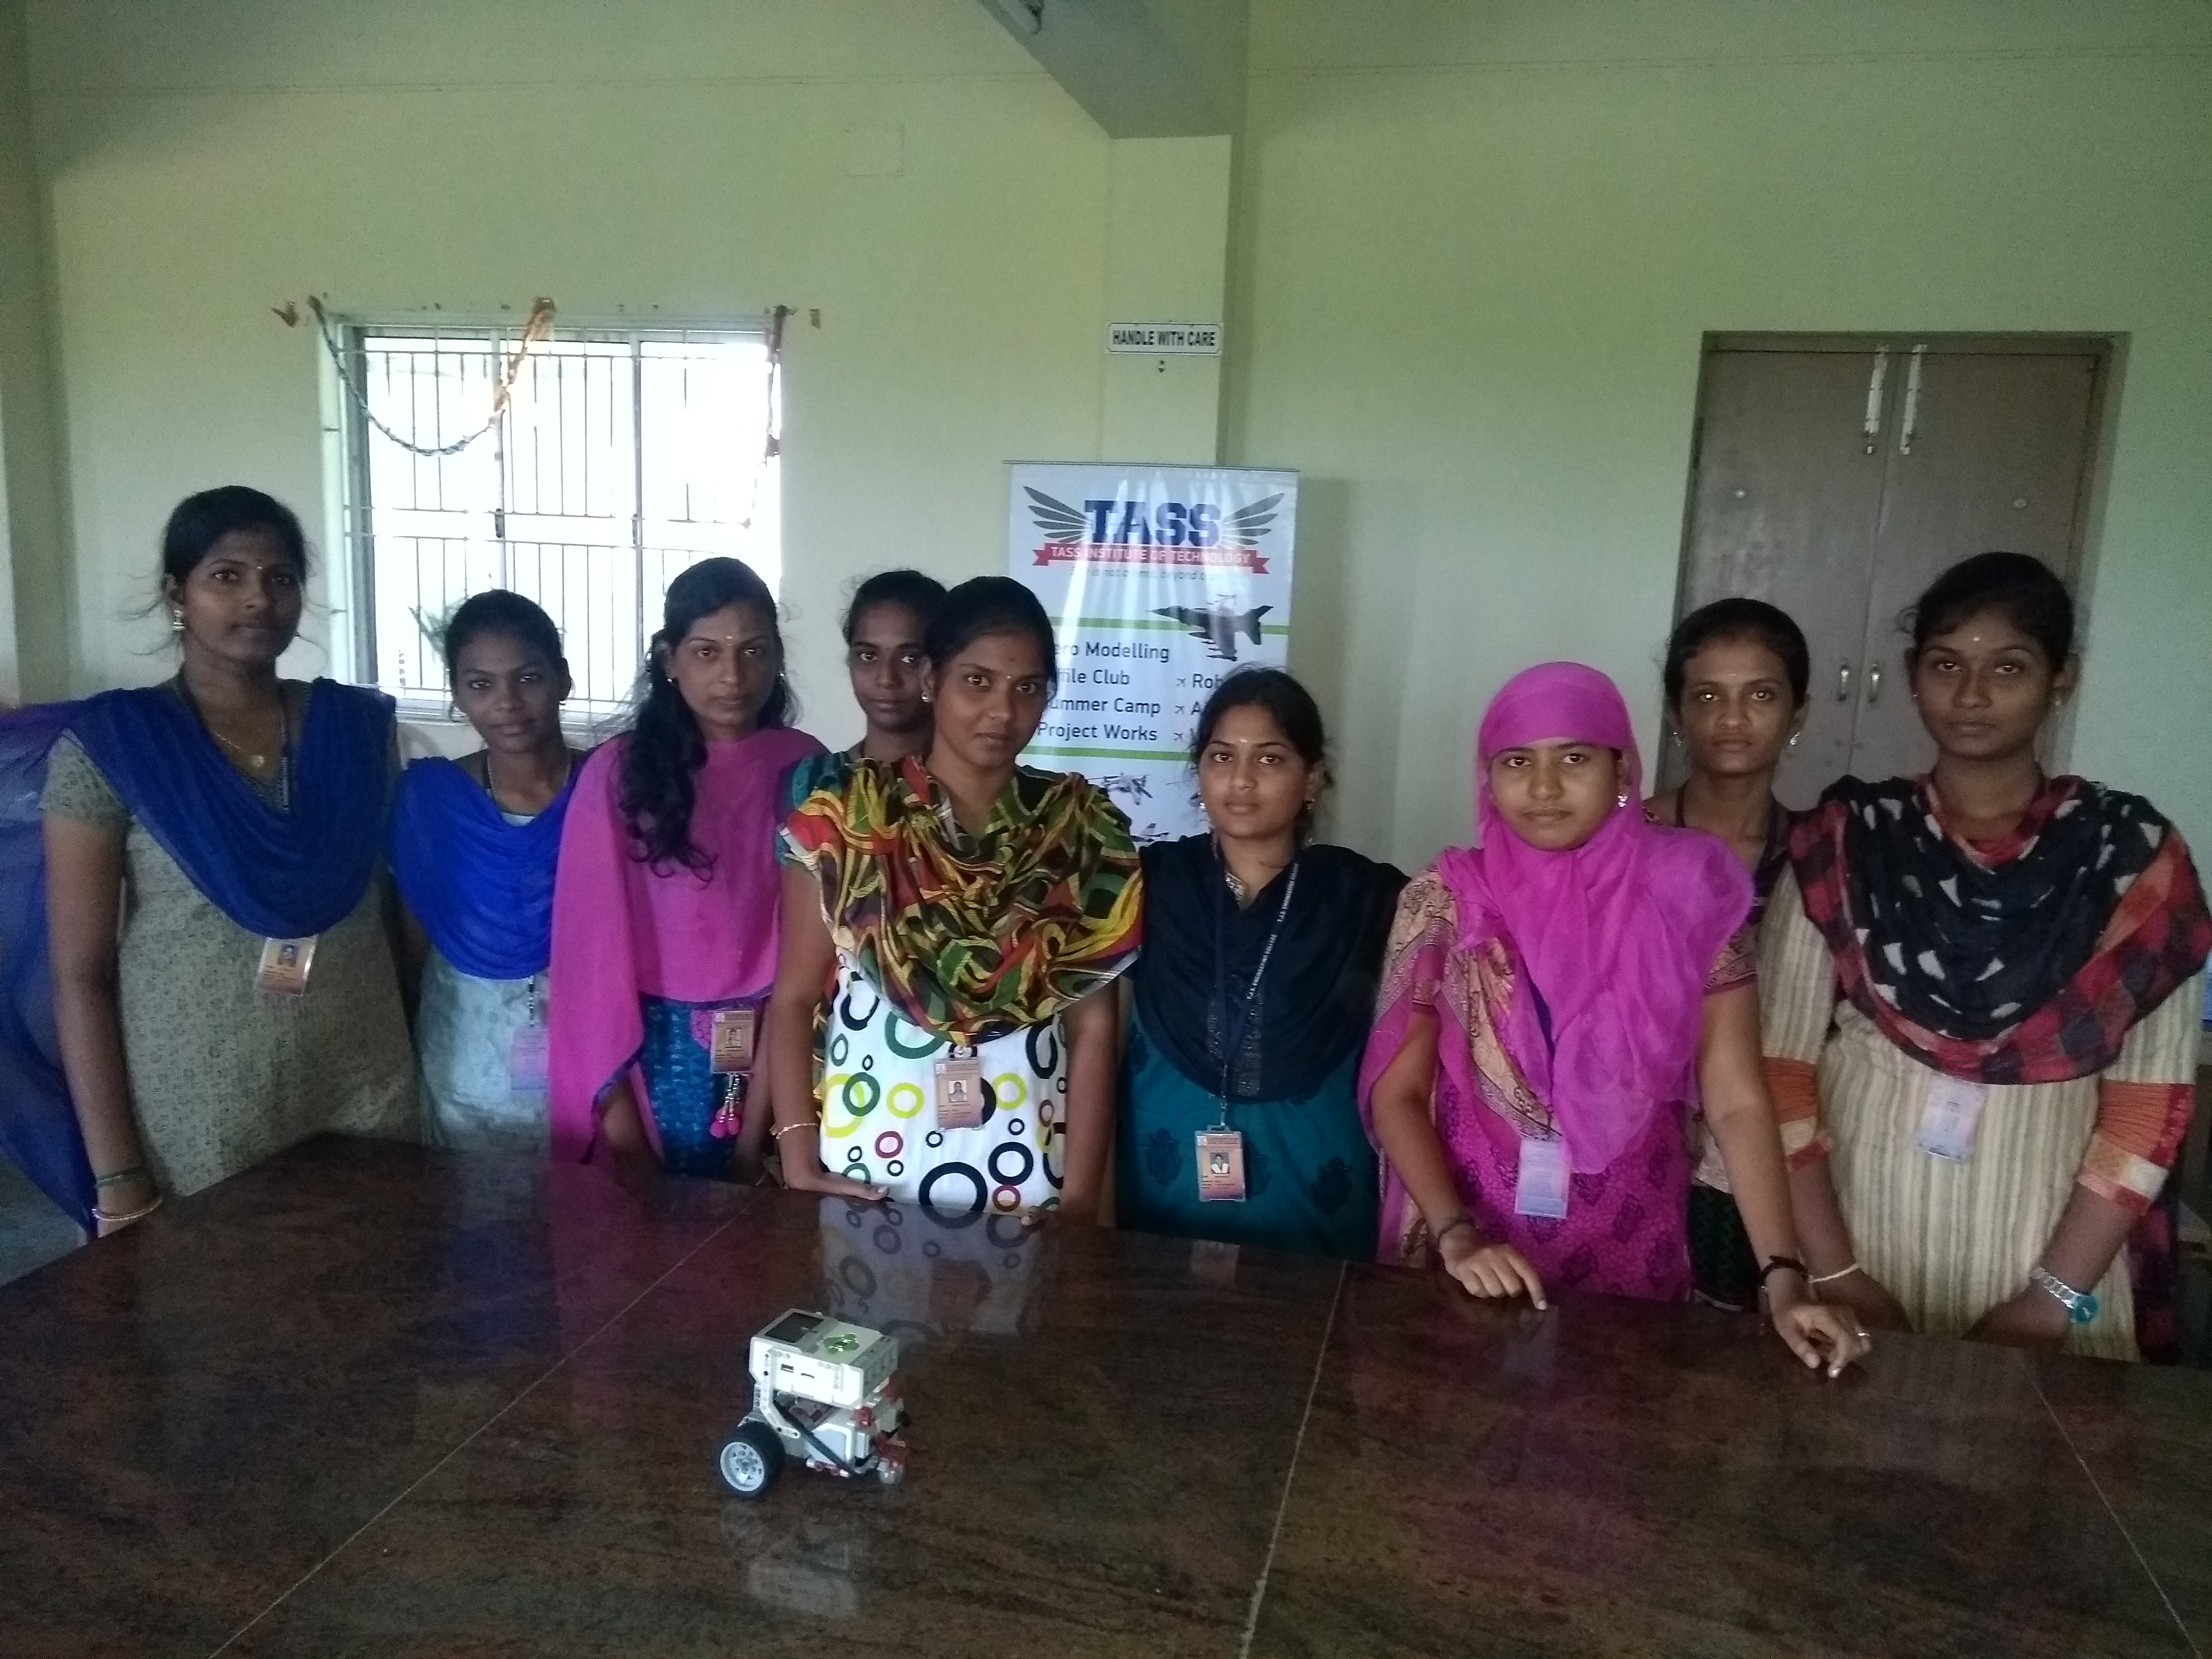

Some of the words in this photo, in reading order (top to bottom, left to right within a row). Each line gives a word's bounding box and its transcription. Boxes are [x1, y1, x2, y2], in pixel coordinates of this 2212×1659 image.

[1113, 330, 1154, 345] HANDLE
[1157, 331, 1185, 346] WITH
[1187, 331, 1216, 346] CARE
[1085, 500, 1221, 547] TASS
[1050, 547, 1080, 557] TASS
[1084, 548, 1147, 560] INSTITUTE
[1171, 550, 1251, 564] TECHNOLOGY
[1085, 641, 1169, 663] Modelling
[1093, 669, 1130, 685] Club
[1050, 698, 1108, 711] ummer
[1114, 698, 1160, 717] Camp
[1038, 721, 1098, 741] Project
[1103, 724, 1158, 741] Works
